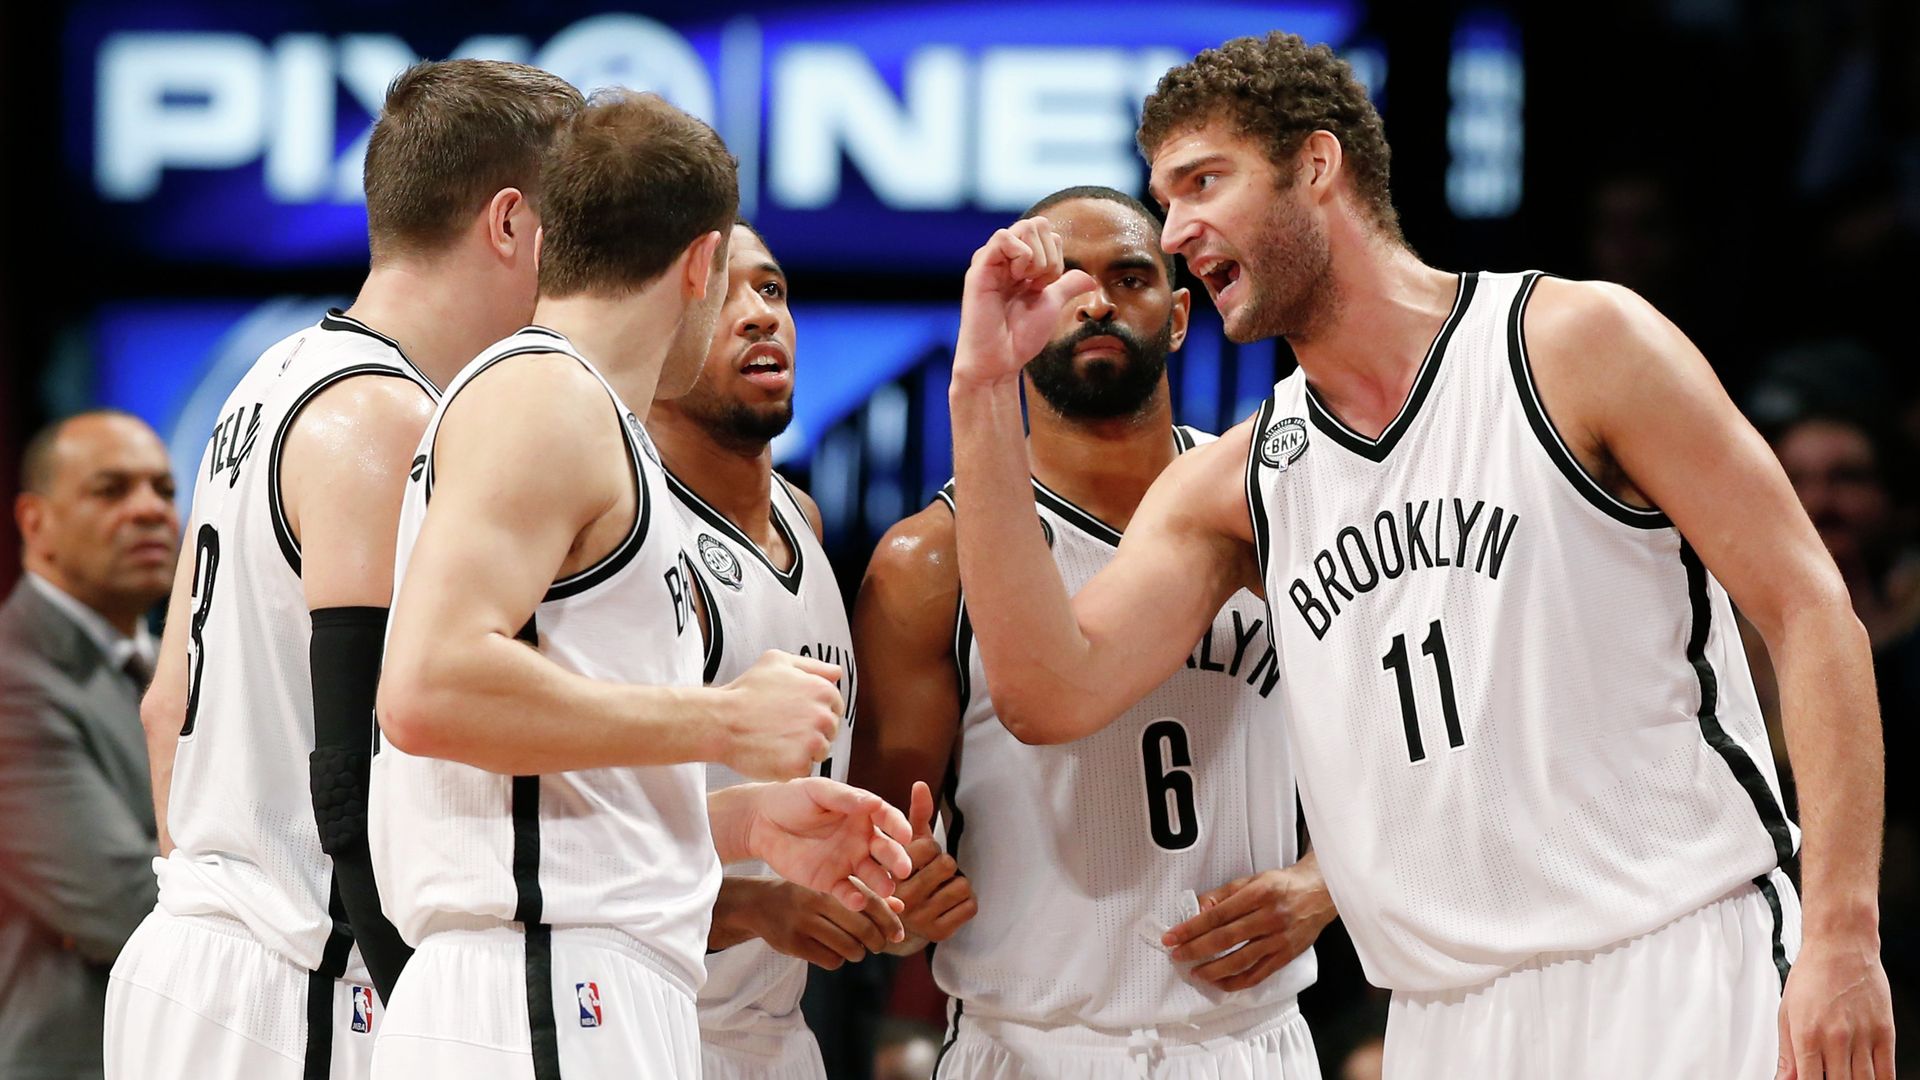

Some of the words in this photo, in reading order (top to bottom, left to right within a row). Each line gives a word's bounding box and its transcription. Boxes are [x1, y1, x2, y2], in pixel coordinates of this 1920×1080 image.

[766, 42, 1388, 213] NE
[1271, 431, 1298, 455] BKN
[1288, 497, 1519, 641] BROOKLYN
[1381, 618, 1465, 763] 11
[1141, 719, 1199, 850] 6
